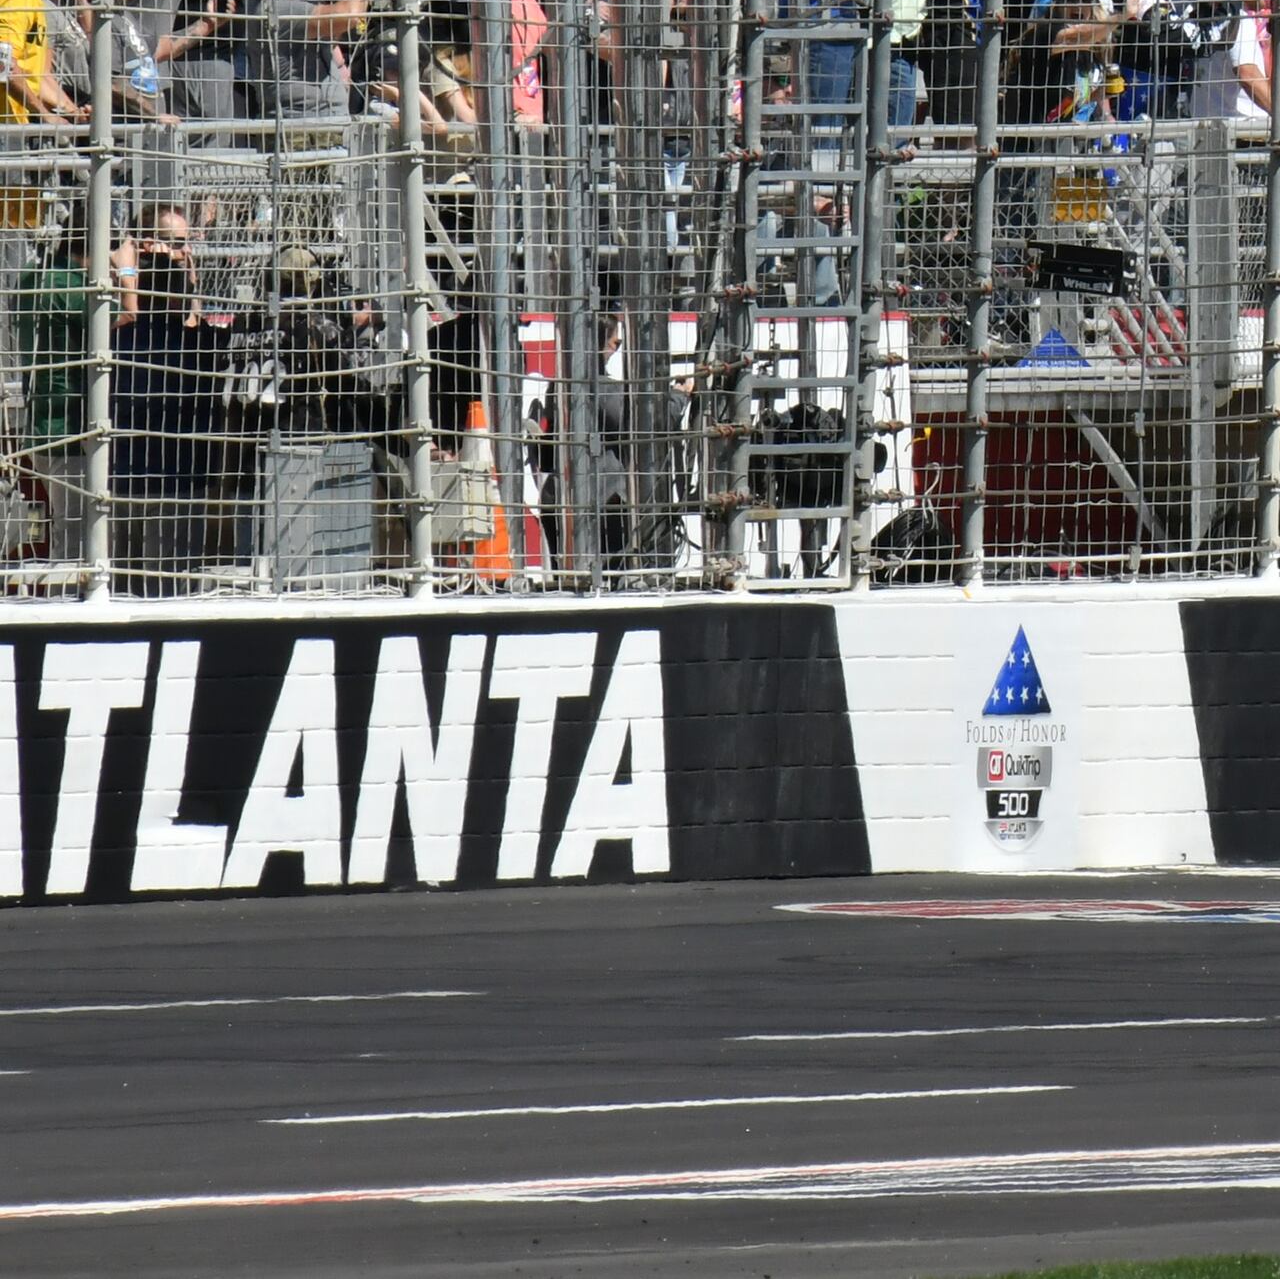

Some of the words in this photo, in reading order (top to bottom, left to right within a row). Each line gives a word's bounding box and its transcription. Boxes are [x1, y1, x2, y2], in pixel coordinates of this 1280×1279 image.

[964, 720, 1004, 743] FOLDS
[1020, 719, 1067, 743] HONOR
[1005, 752, 1041, 781] QuikTrip
[998, 793, 1029, 817] 500
